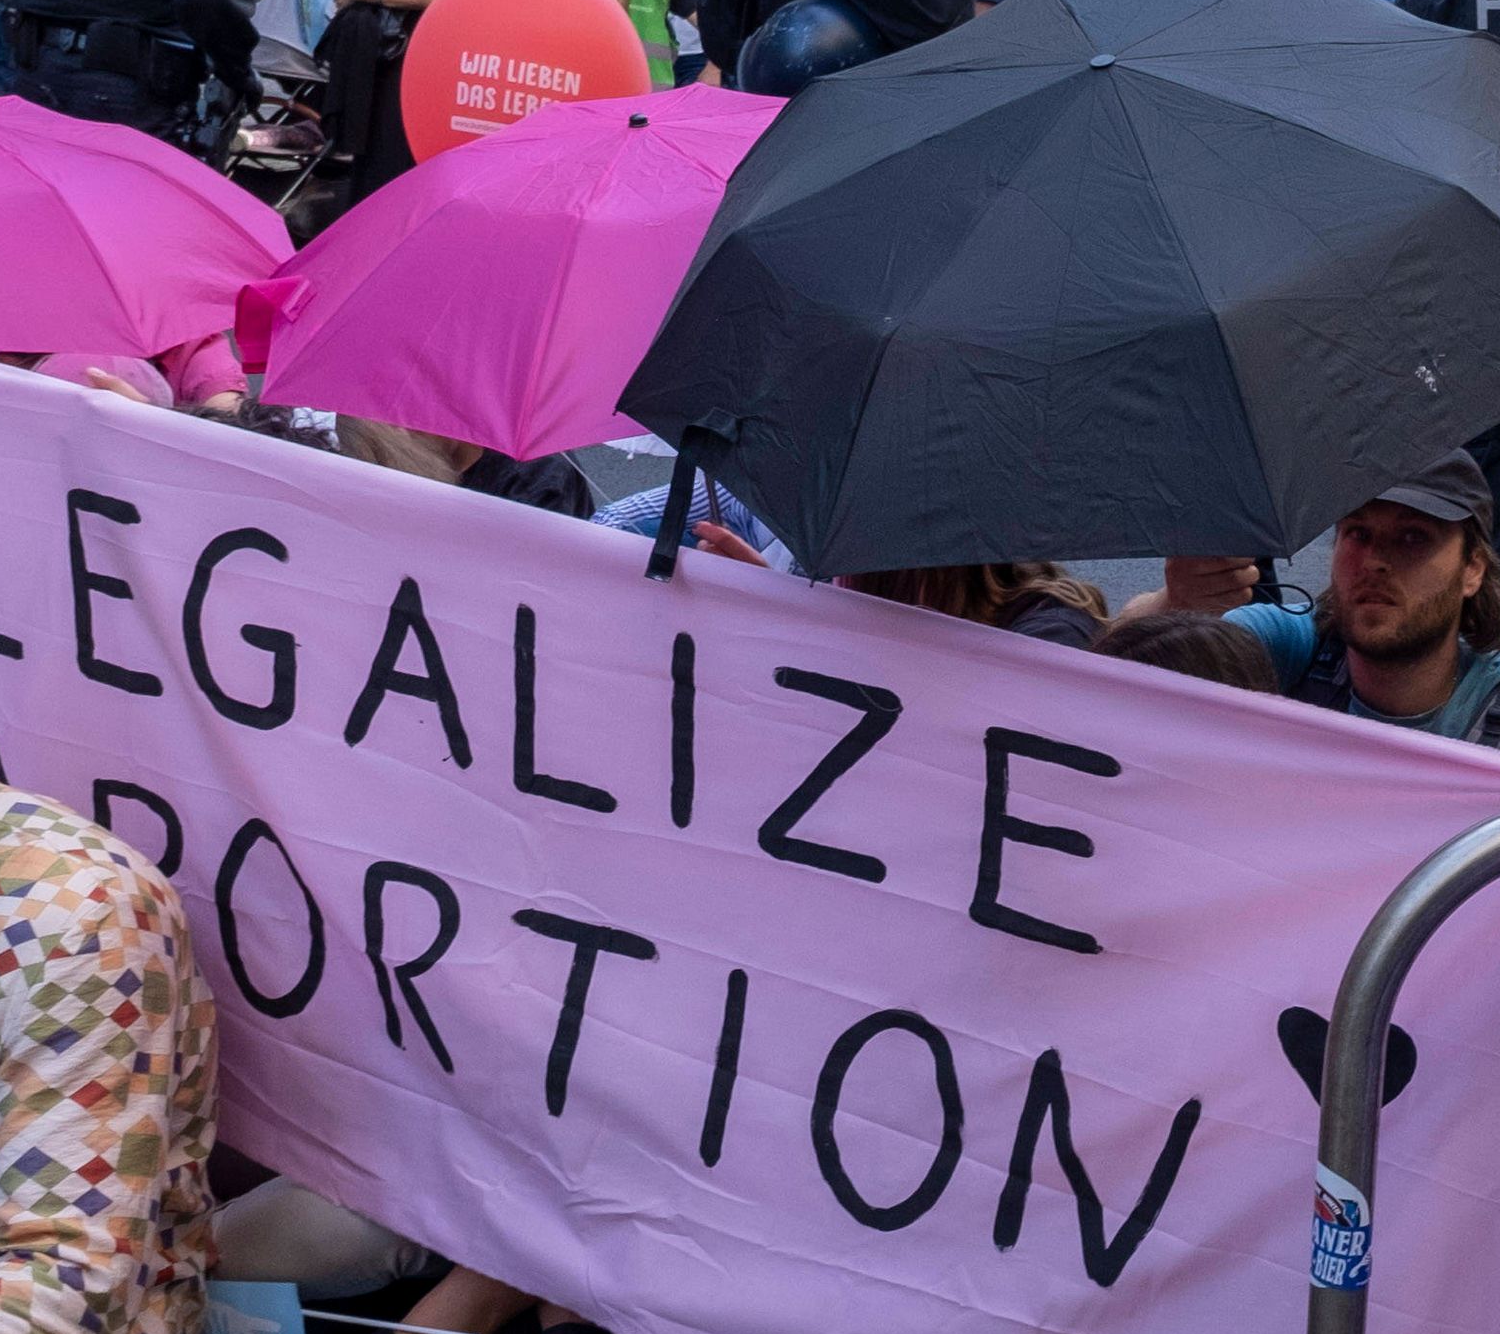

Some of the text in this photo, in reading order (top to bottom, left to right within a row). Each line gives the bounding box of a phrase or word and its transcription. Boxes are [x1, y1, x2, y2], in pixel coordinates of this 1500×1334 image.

[460, 51, 582, 97] WIR LIEBEN
[456, 81, 497, 111] DAS
